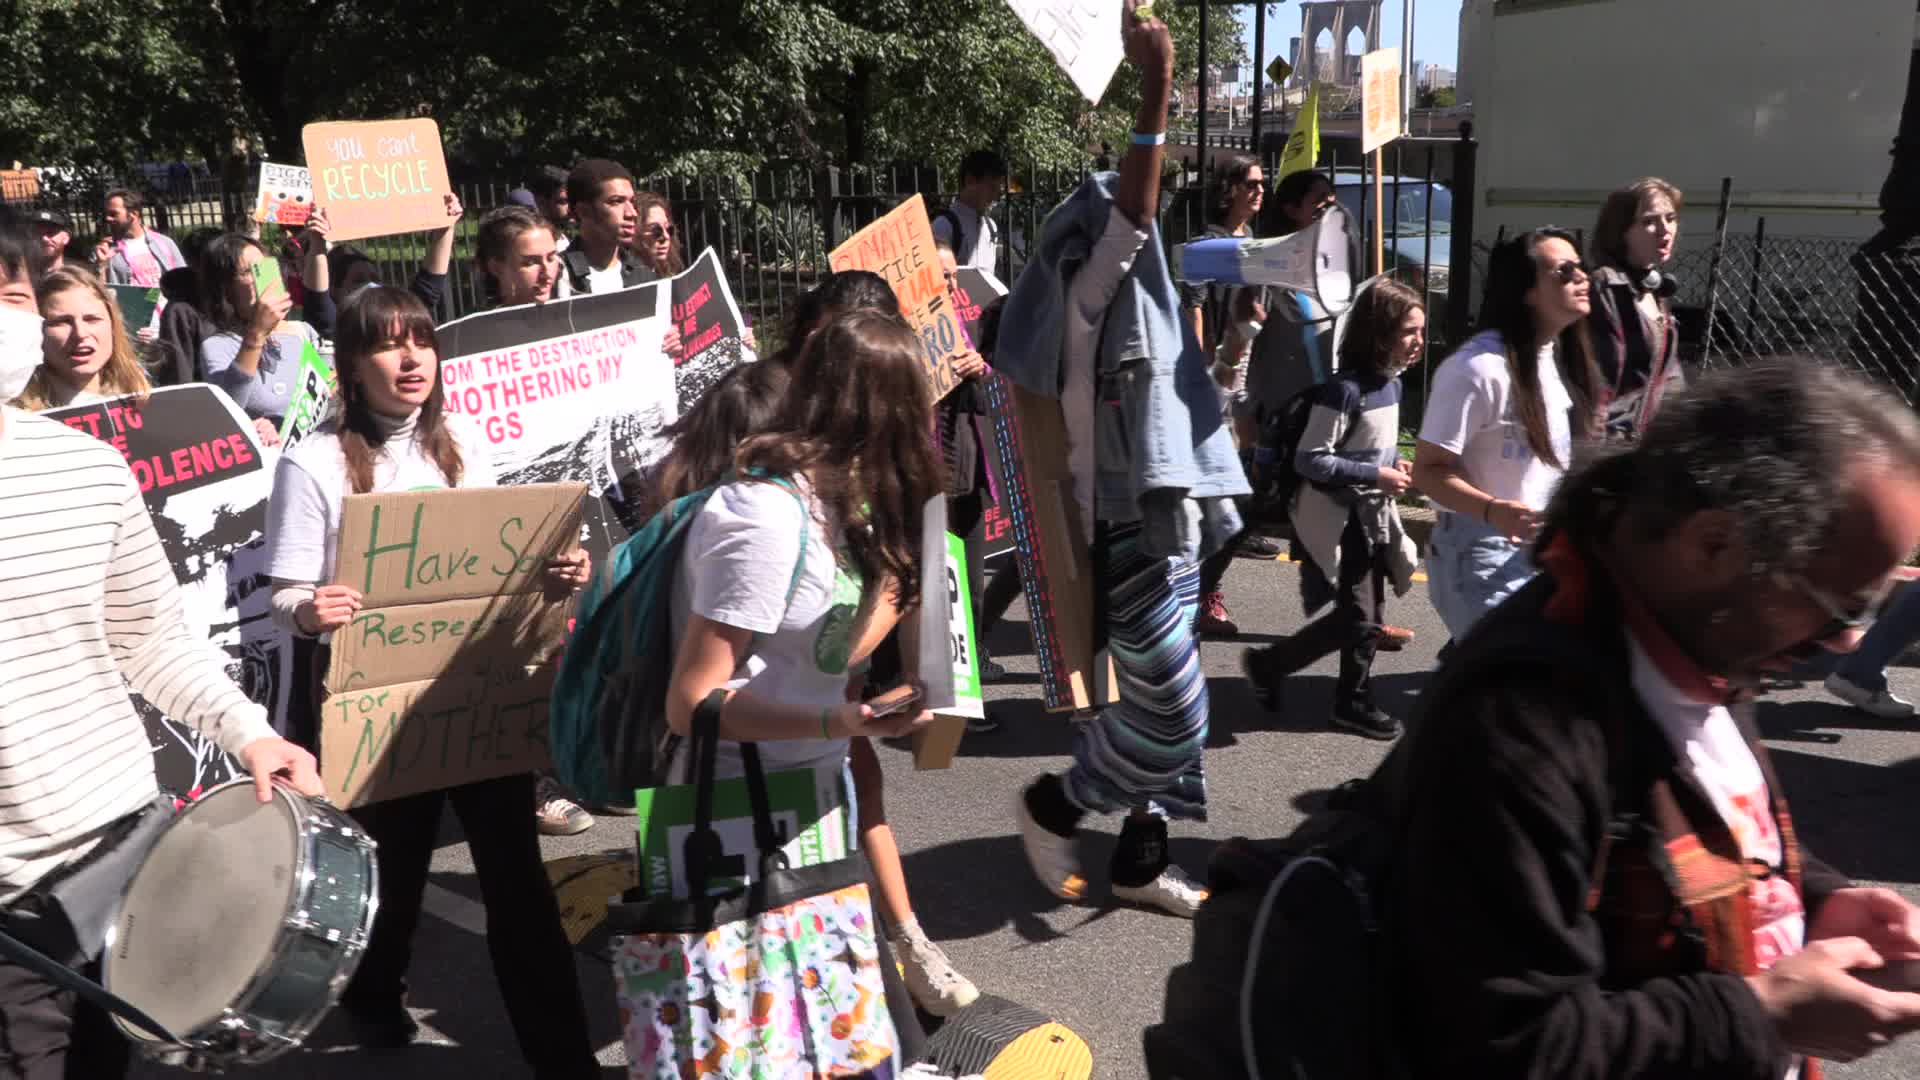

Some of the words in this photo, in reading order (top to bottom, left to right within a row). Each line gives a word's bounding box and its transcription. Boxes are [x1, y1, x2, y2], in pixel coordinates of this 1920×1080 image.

[322, 159, 433, 201] RECYCLE
[879, 244, 925, 283] TICE
[443, 359, 475, 386] OM
[480, 350, 523, 377] THE
[527, 326, 638, 369] DESTRUCTION
[922, 312, 956, 368] RO
[443, 361, 593, 416] MOTHERING
[596, 353, 624, 385] MY
[130, 431, 253, 494] OLENCE
[363, 502, 480, 595] Have
